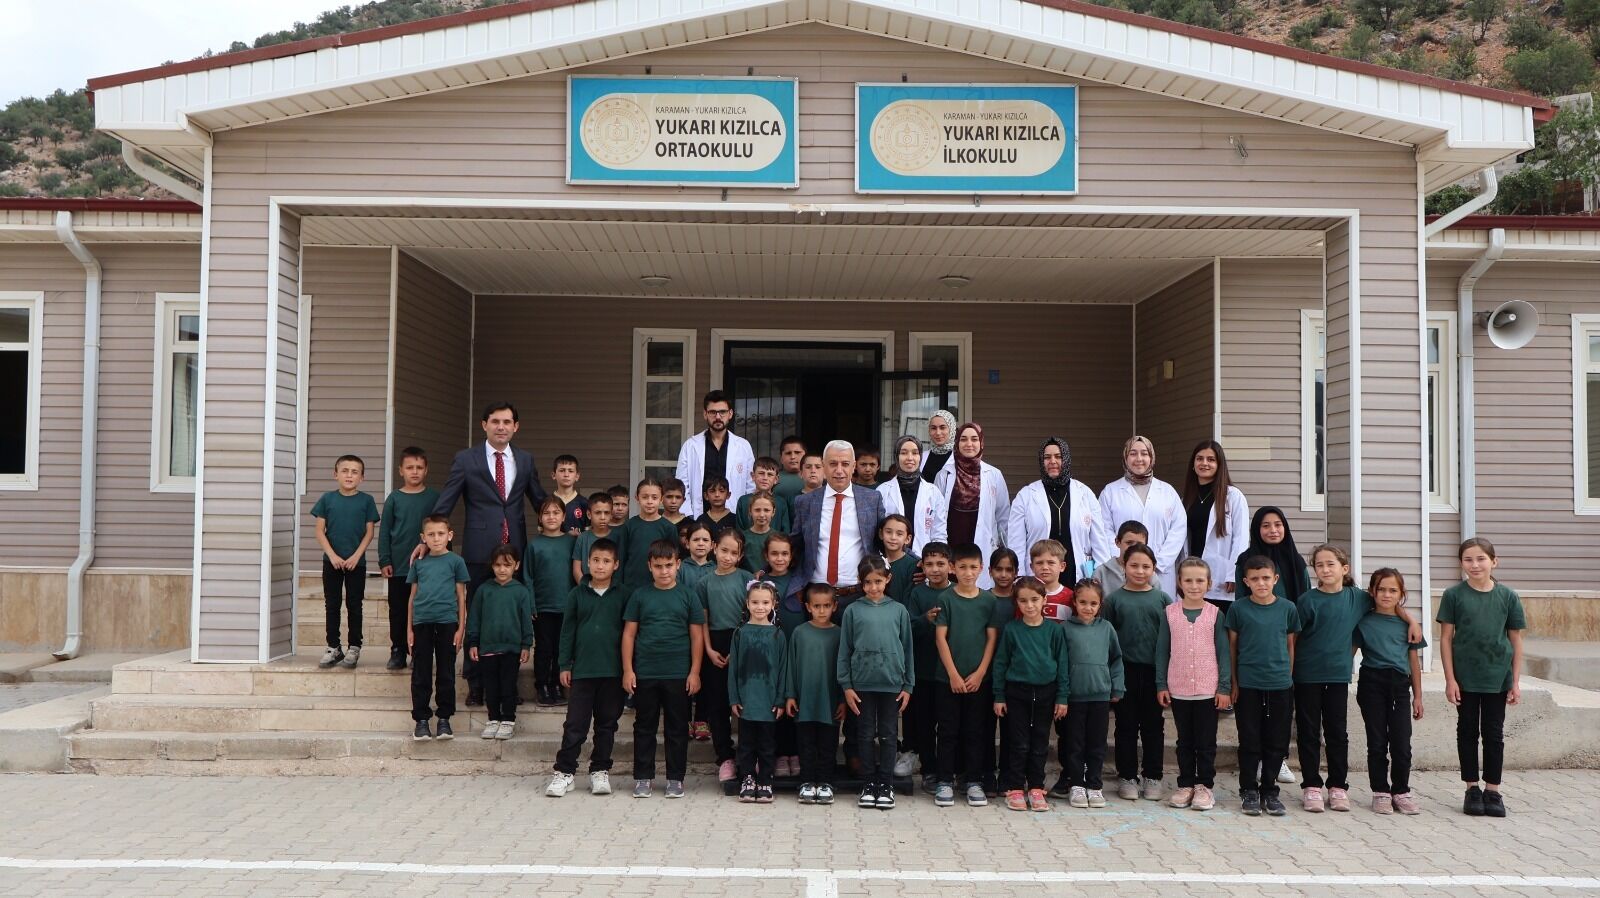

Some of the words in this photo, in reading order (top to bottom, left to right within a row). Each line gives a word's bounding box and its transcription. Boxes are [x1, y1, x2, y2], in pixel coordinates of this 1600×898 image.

[655, 106, 690, 114] KARAMAN
[695, 107, 720, 115] YUKARI
[721, 107, 747, 115] KIZILCA
[943, 112, 976, 120] KARAMAN
[980, 112, 1003, 120] YUKARI
[1005, 112, 1028, 121] KIZILCA
[655, 119, 716, 135] YUKARI
[720, 120, 782, 136] KIZILCA
[943, 125, 999, 141] YUKARI
[1003, 125, 1060, 141] KIZILCA
[655, 142, 753, 158] ORTAOKULU
[943, 145, 1017, 164] İLKOKULU
